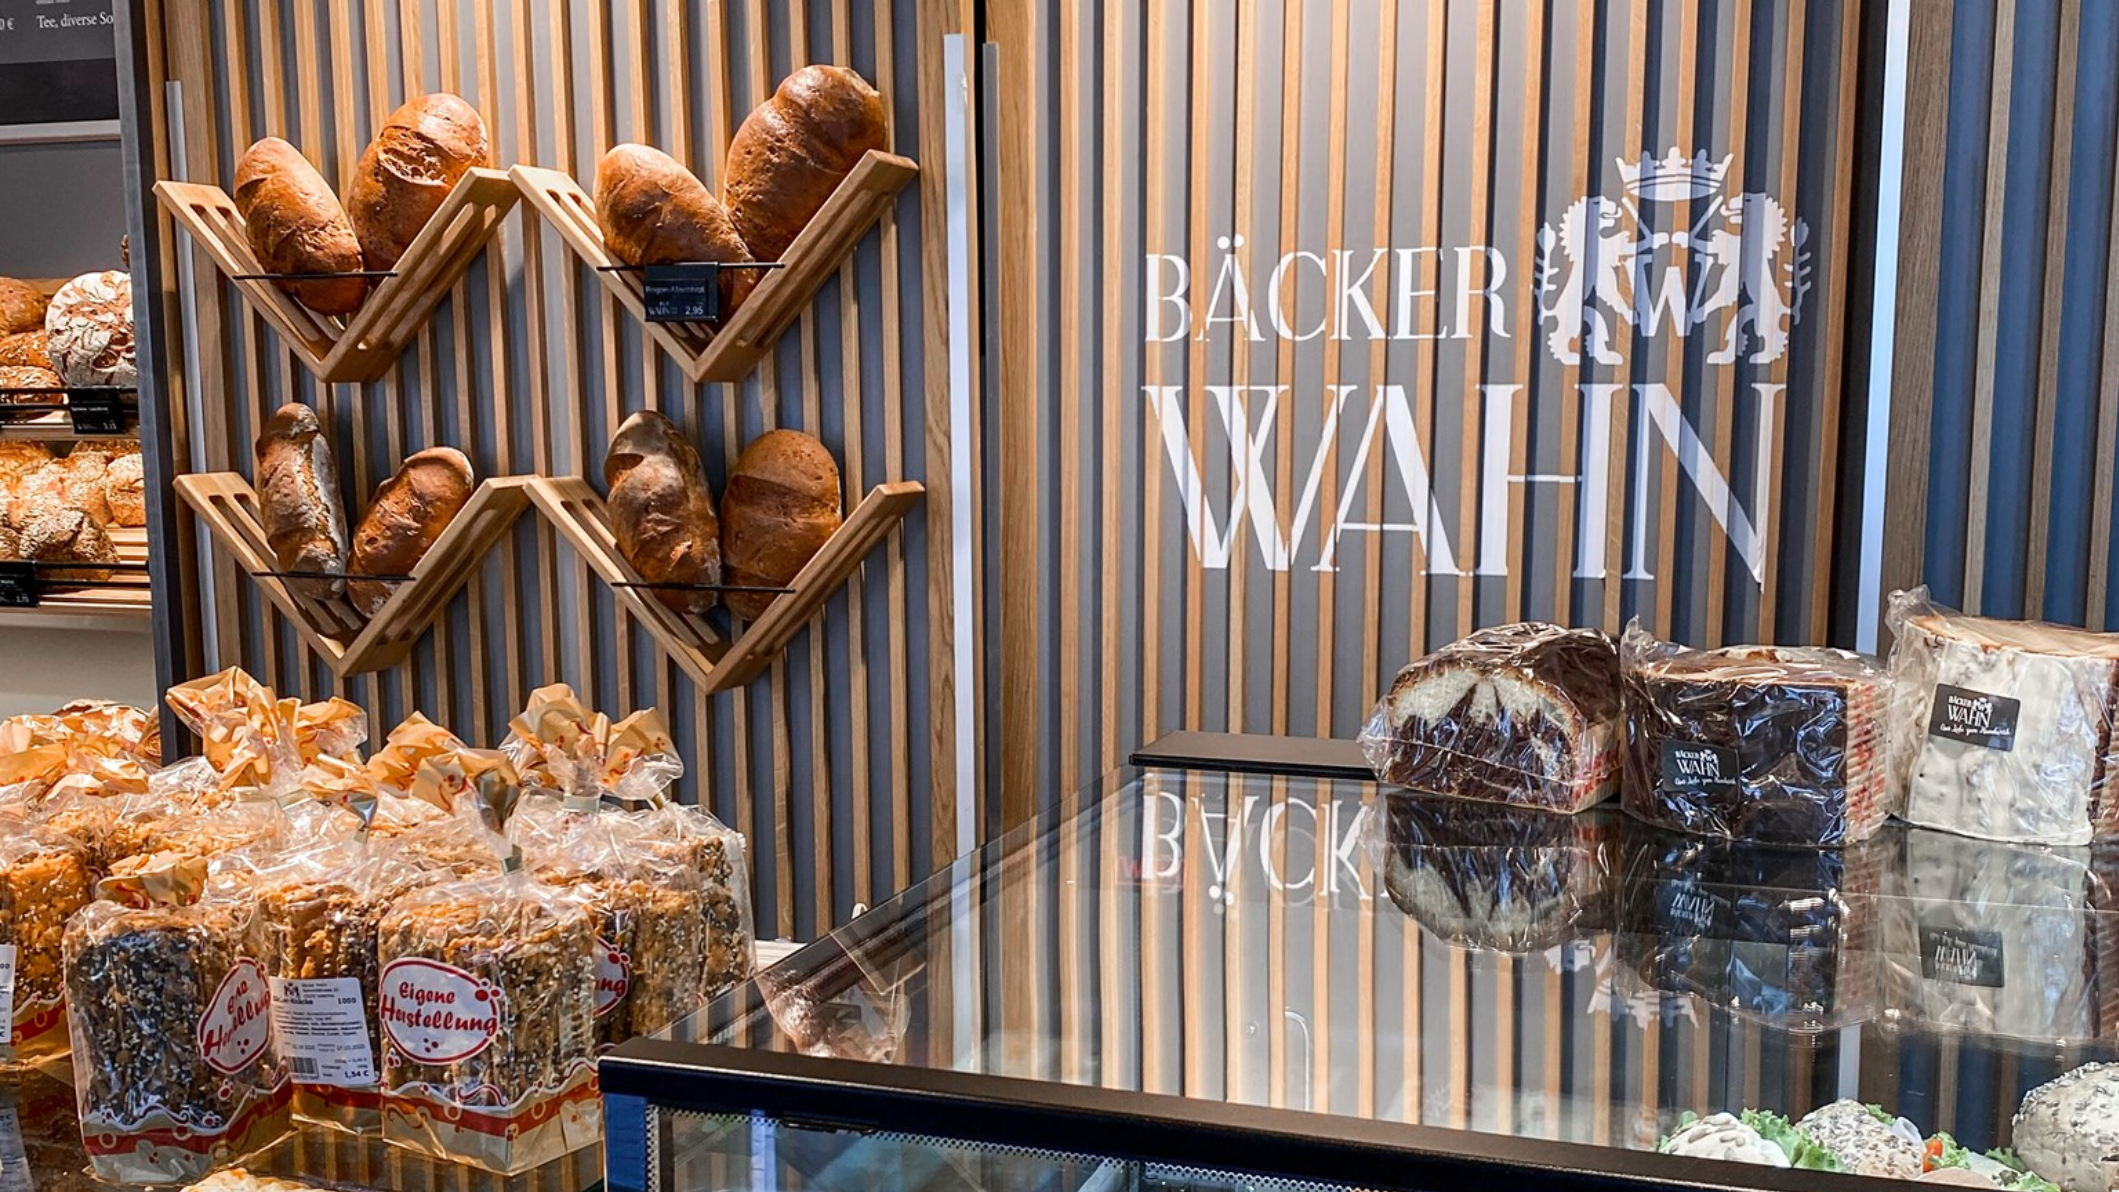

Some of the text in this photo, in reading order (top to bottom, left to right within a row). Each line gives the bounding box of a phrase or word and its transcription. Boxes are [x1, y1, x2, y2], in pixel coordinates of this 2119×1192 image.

[60, 13, 97, 27] diverse
[1144, 234, 1511, 342] BÄCKER
[1141, 383, 1787, 594] WAHN
[1948, 704, 1991, 728] WAHN
[1676, 759, 1720, 777] WAHN
[399, 981, 456, 1006] Eigene
[381, 993, 498, 1037] Herstellung
